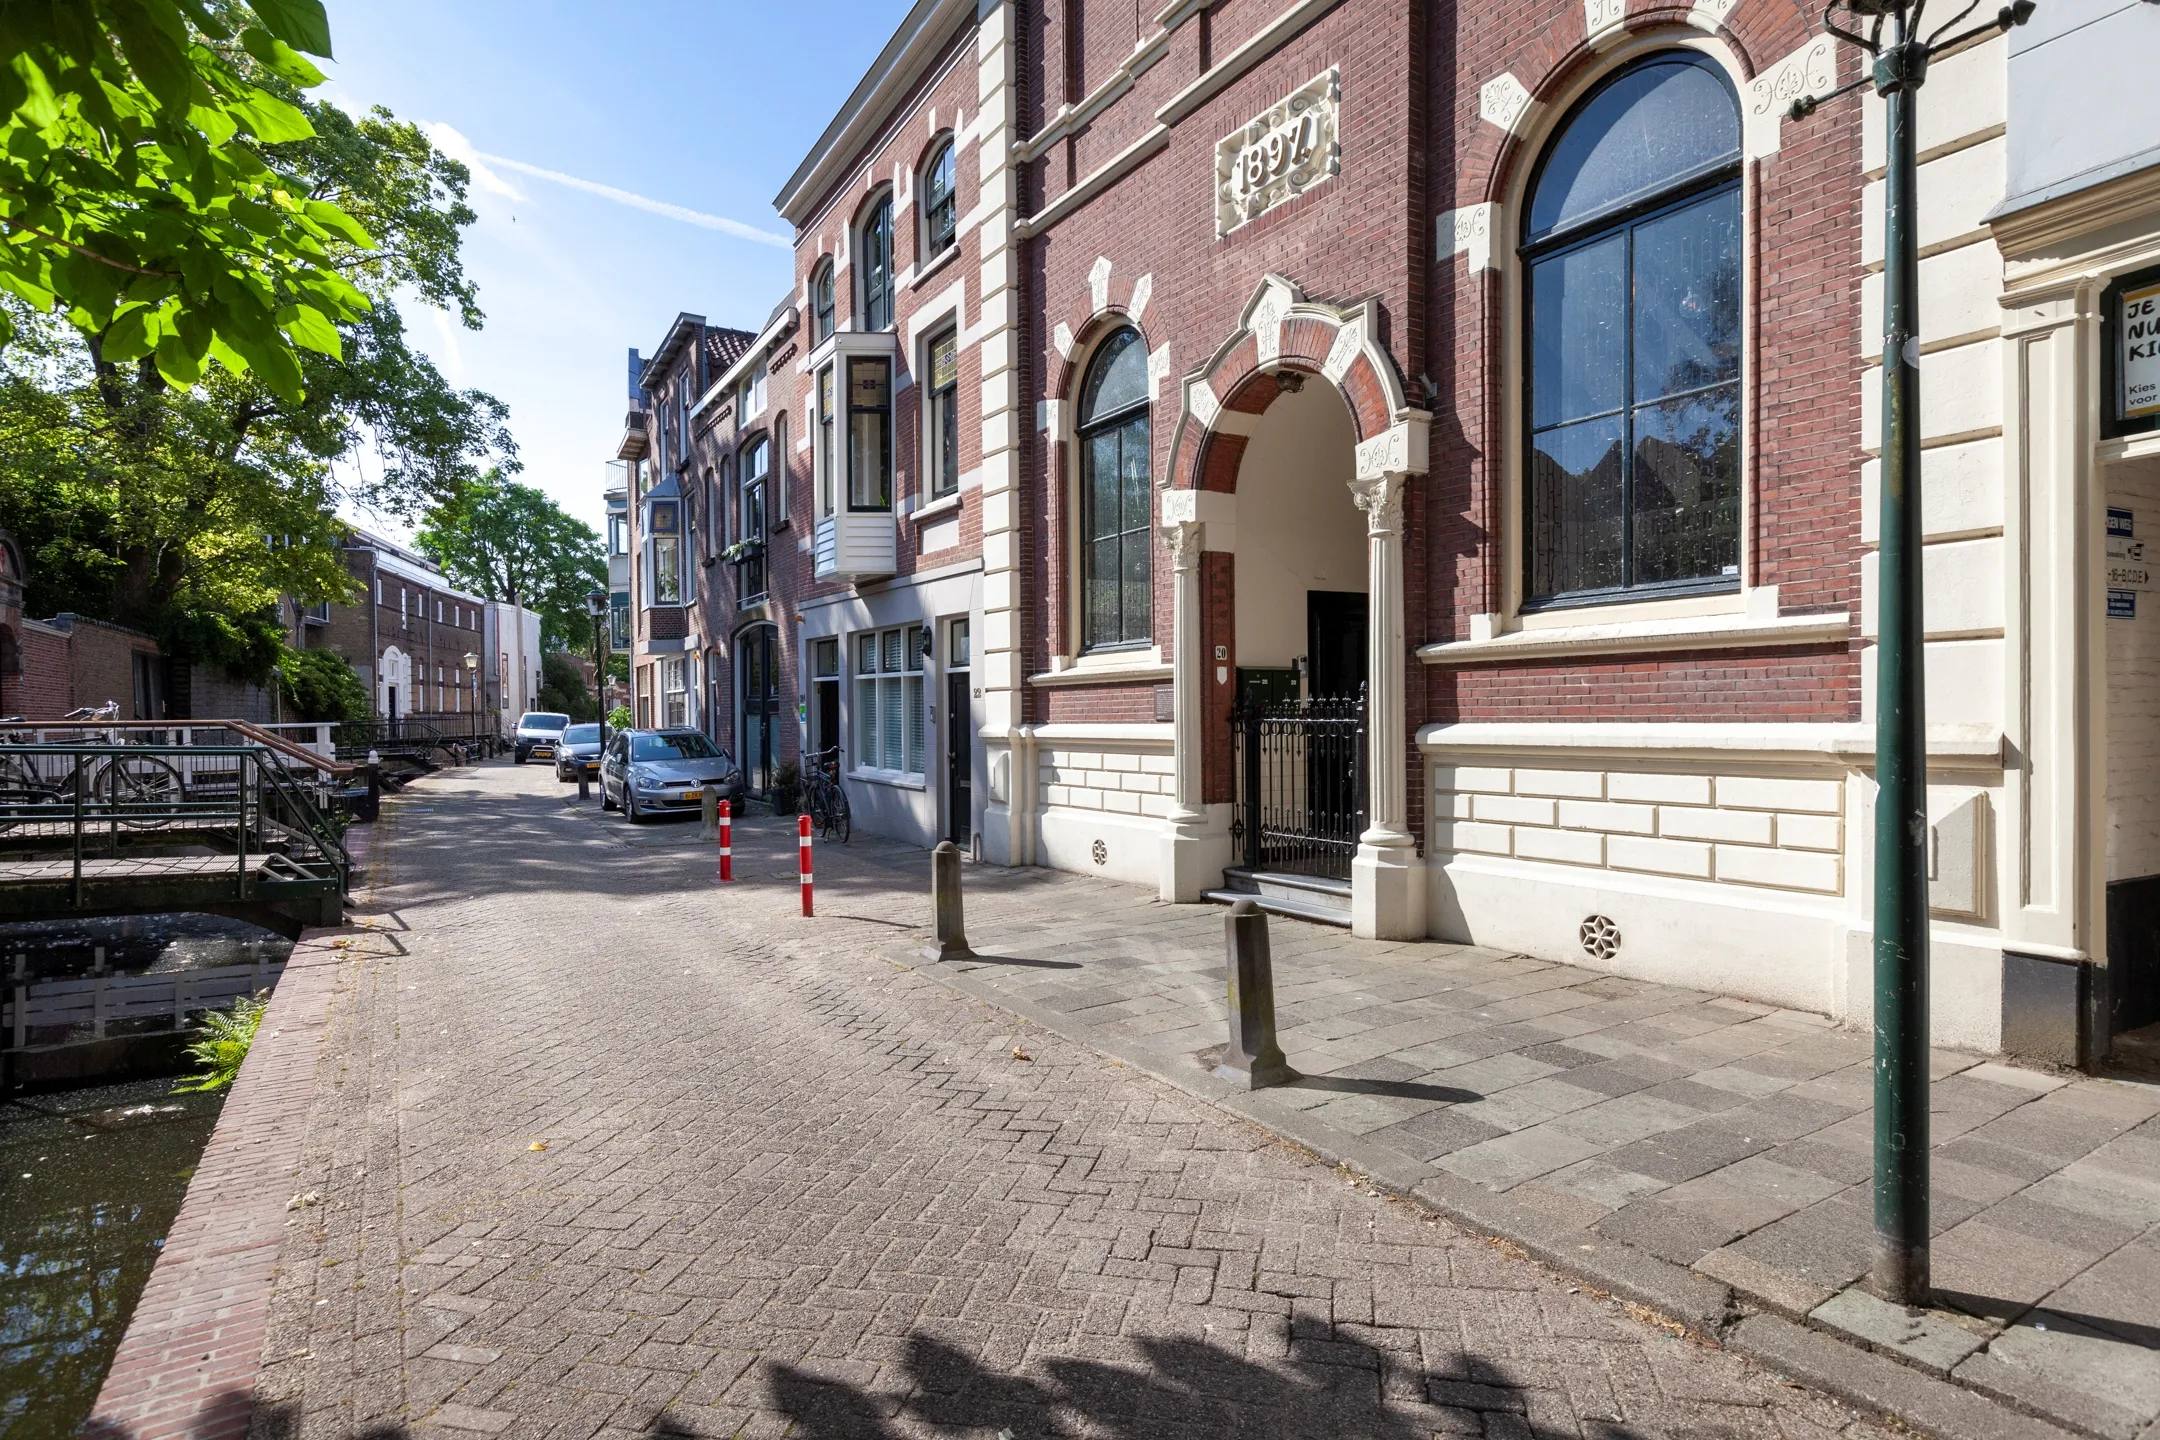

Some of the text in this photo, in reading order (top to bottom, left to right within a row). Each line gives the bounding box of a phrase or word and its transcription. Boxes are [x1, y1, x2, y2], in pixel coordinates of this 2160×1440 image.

[2127, 300, 2156, 319] JE
[2129, 383, 2156, 395] Kies
[2129, 394, 2158, 405] voor
[1217, 647, 1226, 659] 20
[973, 687, 982, 699] 22
